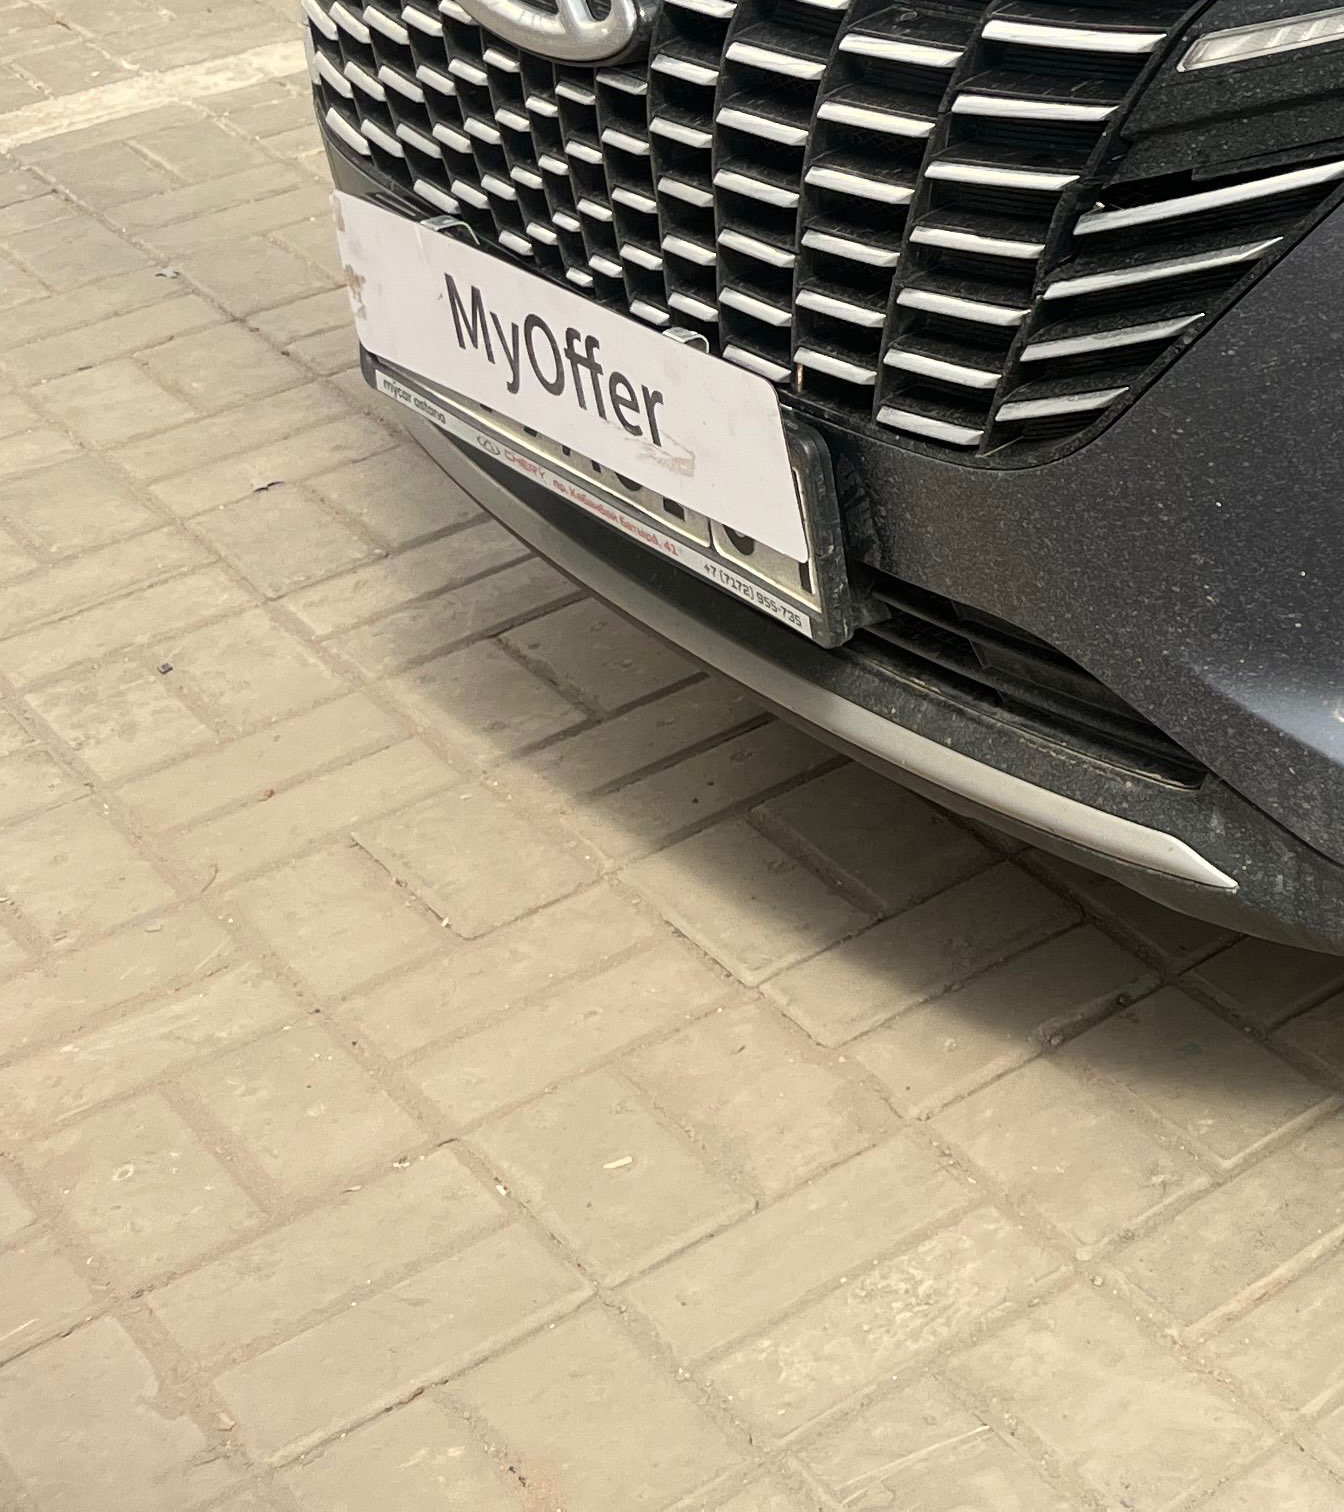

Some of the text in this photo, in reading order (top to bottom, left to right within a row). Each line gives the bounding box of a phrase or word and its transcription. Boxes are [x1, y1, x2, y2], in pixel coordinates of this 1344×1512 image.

[444, 272, 664, 447] MyOffer
[504, 449, 546, 479] CHERY
[703, 563, 802, 627] +7 (7172) 955-735
